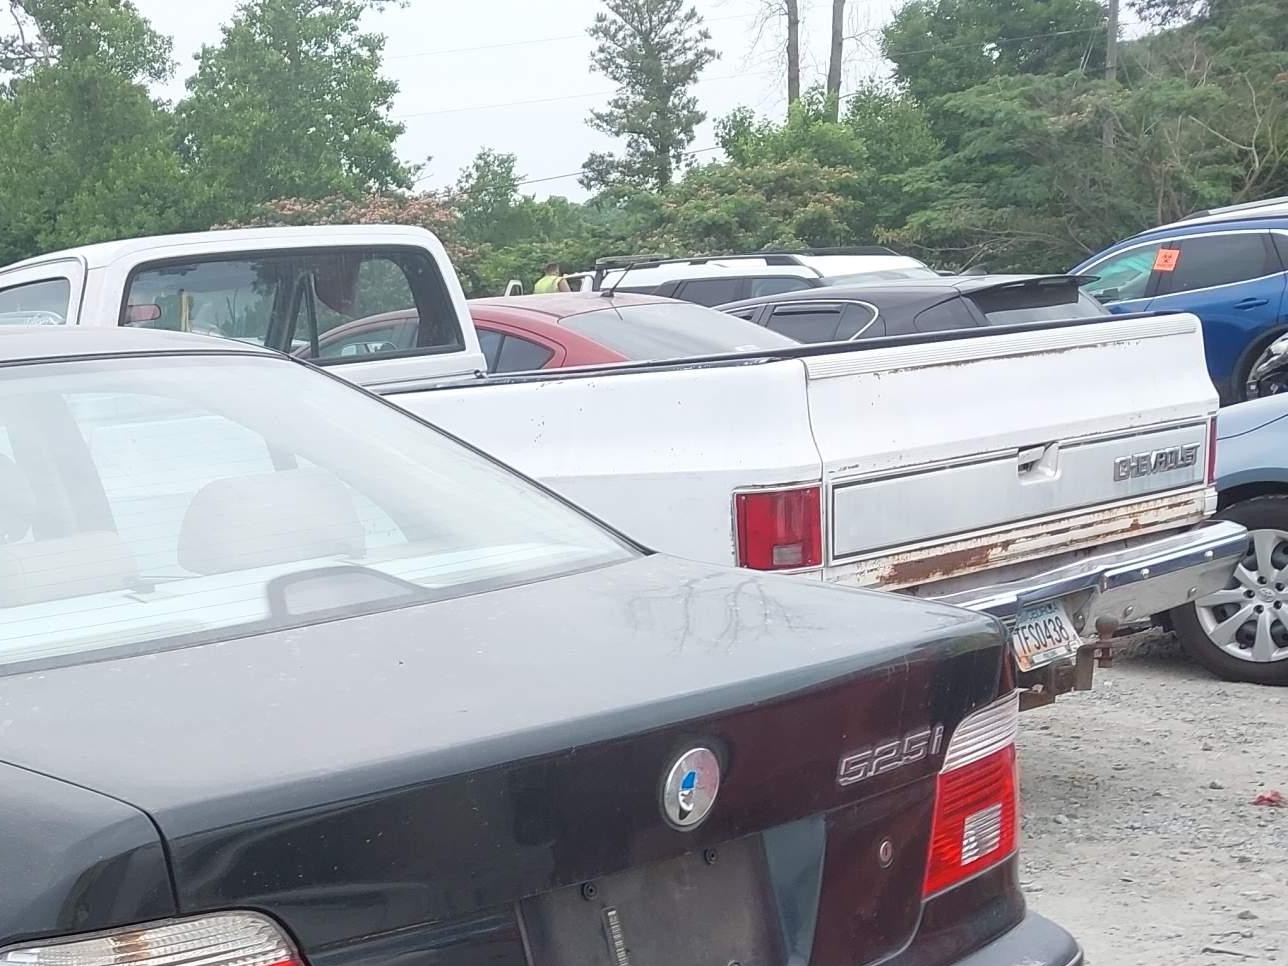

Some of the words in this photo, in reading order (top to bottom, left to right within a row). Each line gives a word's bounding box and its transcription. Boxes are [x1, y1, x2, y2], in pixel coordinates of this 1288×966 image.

[1113, 442, 1201, 482] CHEVROLET
[1015, 615, 1070, 655] TFS0438
[838, 725, 945, 786] 525i
